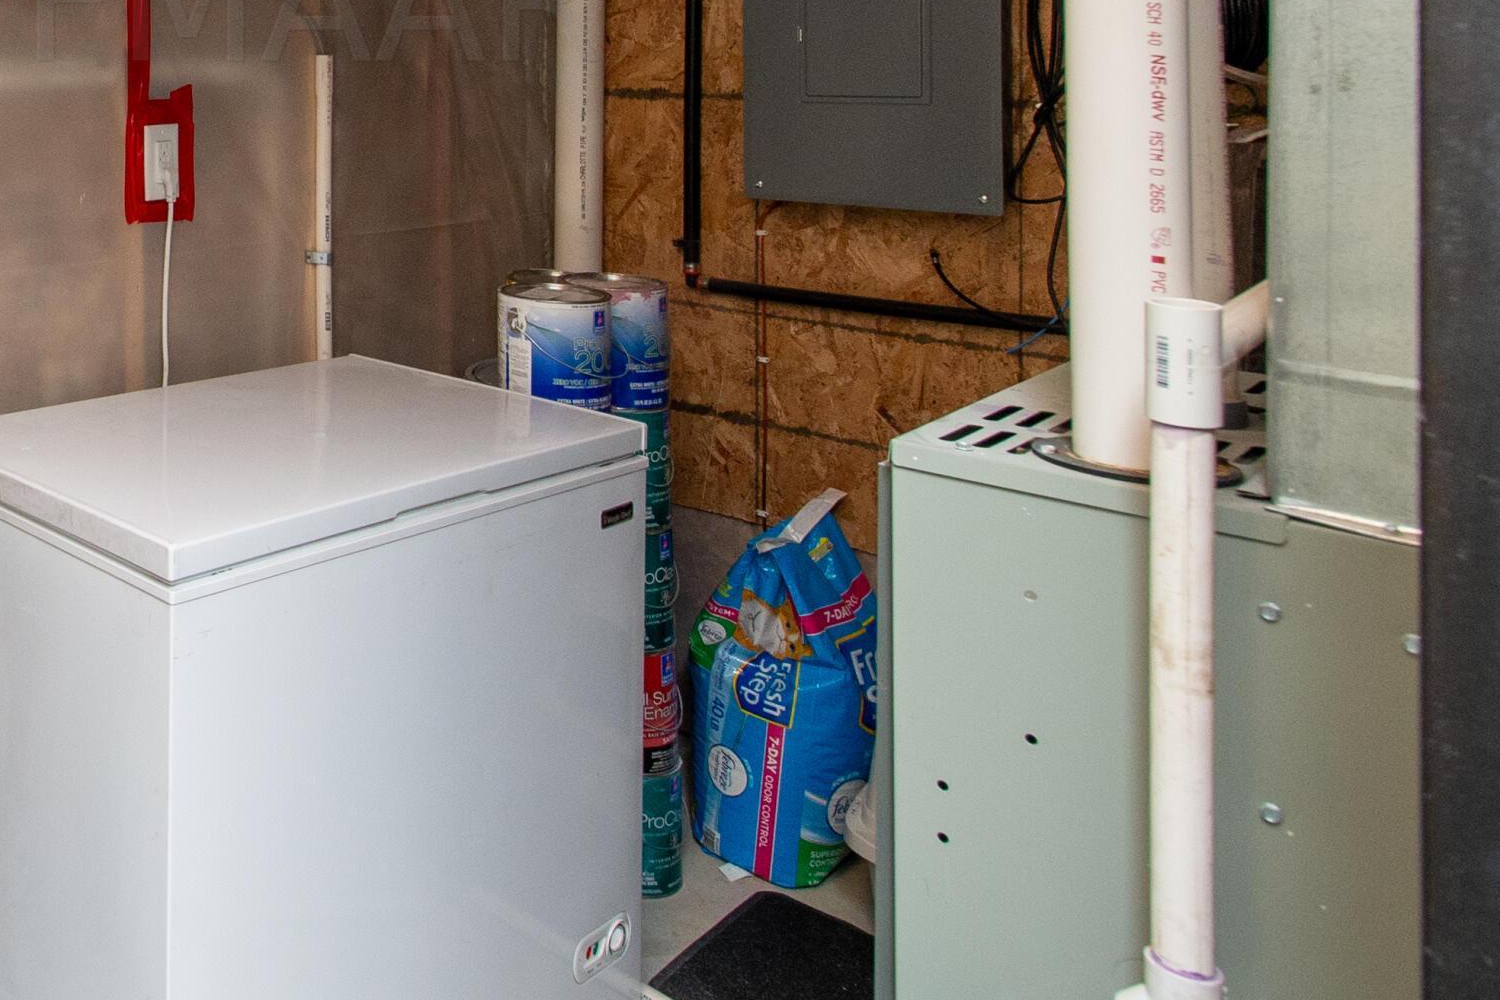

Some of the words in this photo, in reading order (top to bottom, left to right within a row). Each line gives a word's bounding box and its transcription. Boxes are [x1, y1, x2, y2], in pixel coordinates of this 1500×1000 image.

[1146, 2, 1162, 25] SCH
[1147, 31, 1163, 47] 40
[1148, 131, 1166, 162] ASTM
[1150, 270, 1167, 294] PVC
[740, 658, 777, 706] Step
[762, 663, 792, 717] Fresh
[765, 735, 780, 774] 7-DAY
[761, 774, 774, 808] ODOR
[758, 807, 771, 848] CONTROL
